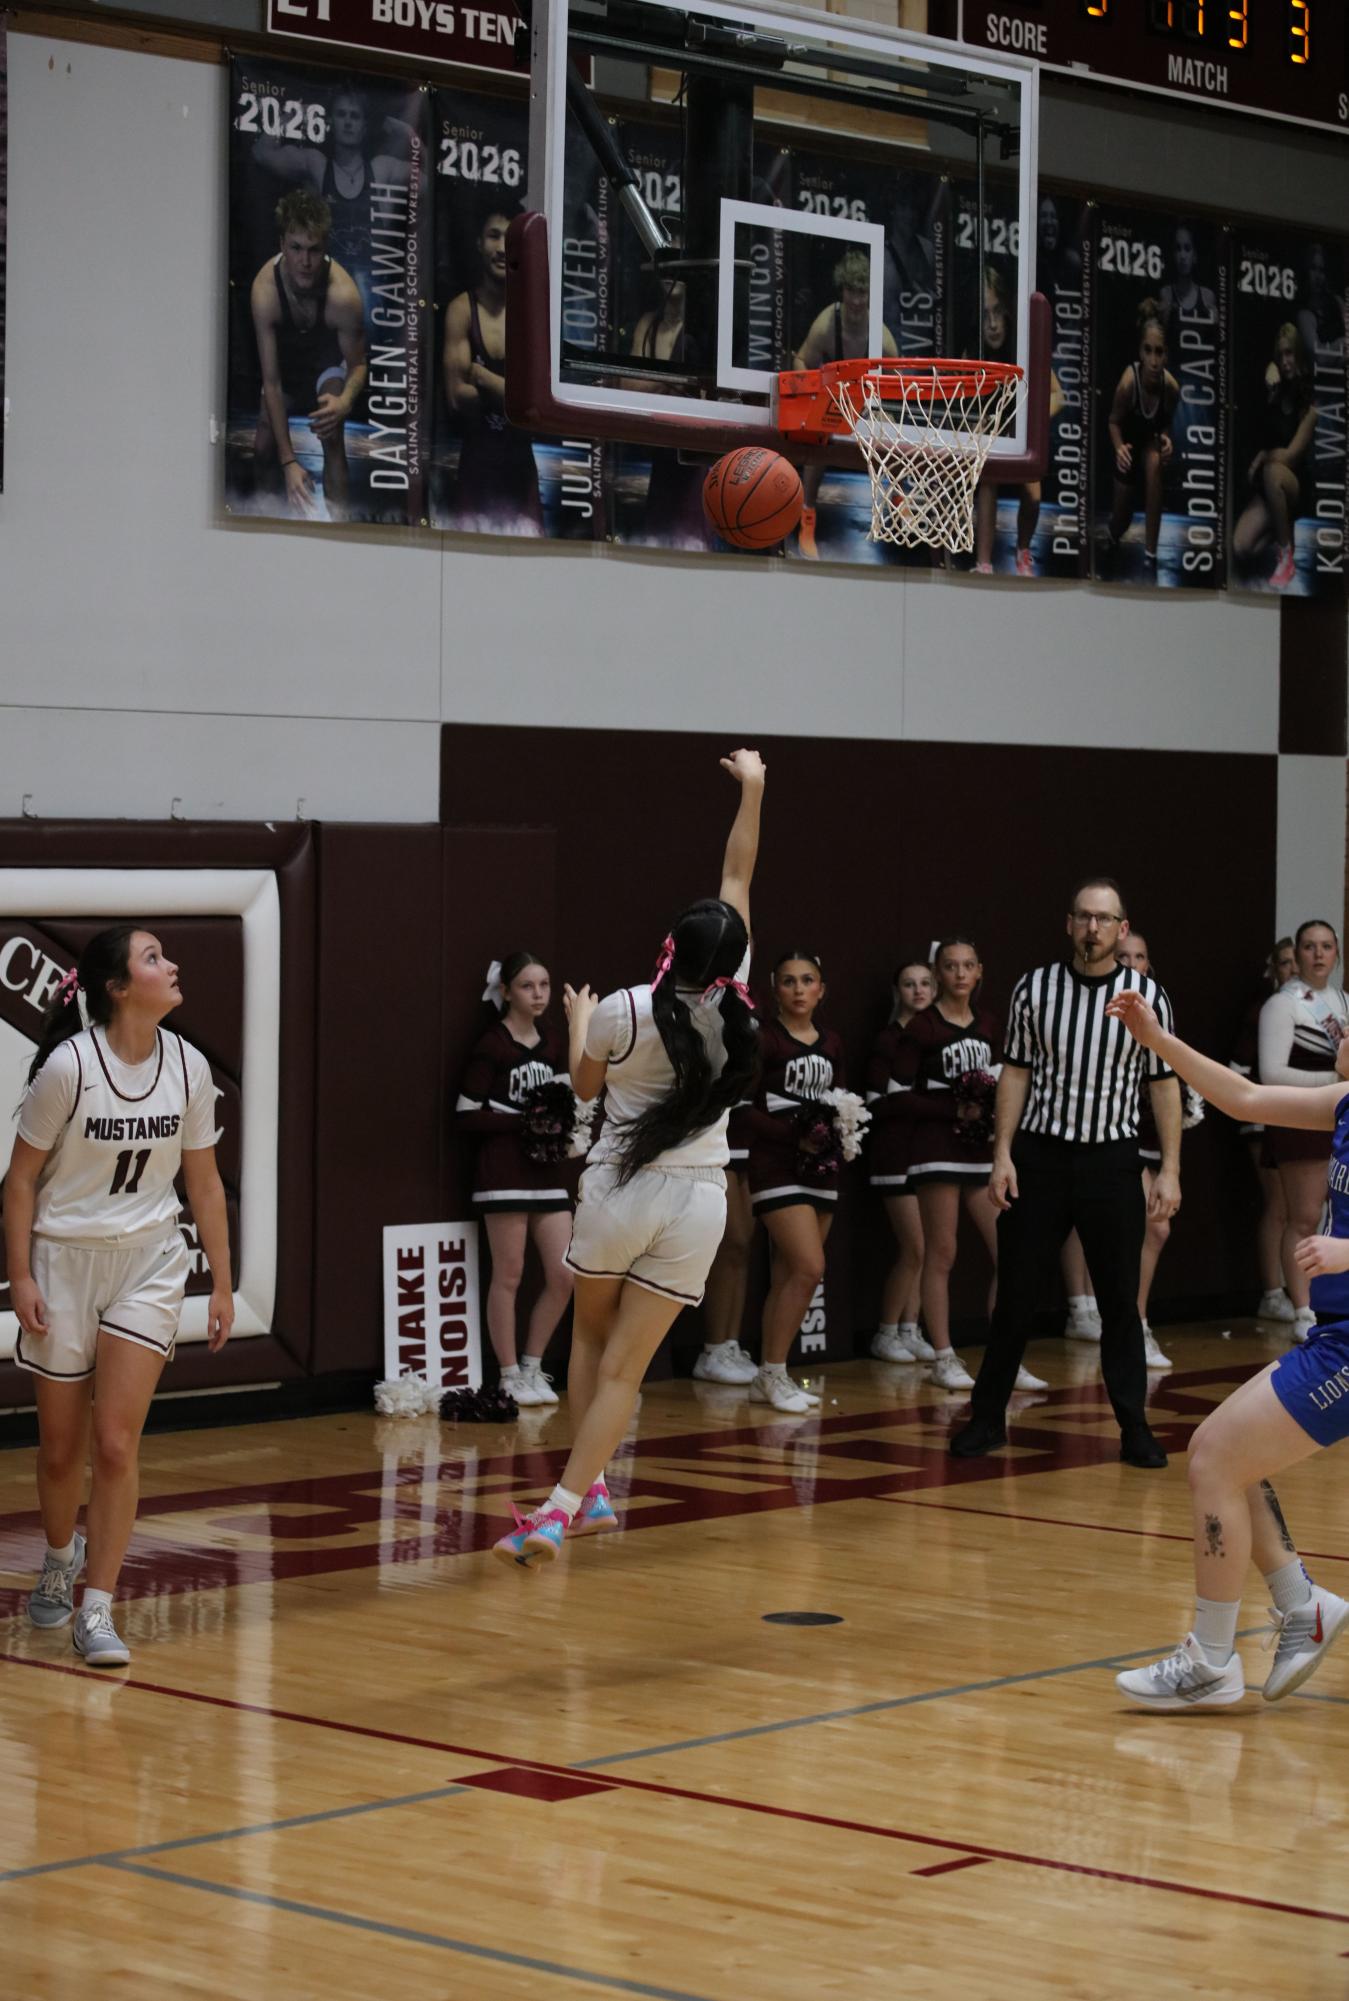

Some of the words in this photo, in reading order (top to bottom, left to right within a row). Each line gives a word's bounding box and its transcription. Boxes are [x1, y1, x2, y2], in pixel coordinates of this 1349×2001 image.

[371, 0, 454, 34] BOYS
[461, 8, 528, 46] TEN
[986, 12, 1048, 54] SCORE
[242, 76, 286, 97] Senior
[1167, 54, 1229, 94] MATCH
[236, 92, 328, 144] 2026
[443, 120, 484, 141] Senior
[408, 135, 421, 224] WRESTLING
[438, 138, 521, 187] 2026
[628, 148, 667, 169] Senior
[597, 176, 609, 259] WRESTLING
[370, 181, 409, 328] GAWITH
[406, 231, 418, 296] SCHOOL
[1098, 236, 1165, 280] 2026
[1237, 260, 1298, 301] 2026
[407, 301, 418, 341] HIGH
[597, 266, 608, 327] SCHOOL
[1051, 282, 1083, 408] Bohrer
[1179, 306, 1216, 406] CAPE
[408, 348, 419, 414] CENTRAL
[1313, 339, 1346, 460] WAITE
[368, 344, 409, 489] DAYGEN
[408, 420, 419, 475] SALINA
[593, 446, 602, 498] SALINA
[1053, 422, 1082, 555] Phoebe
[1182, 424, 1218, 573] Sophia
[1315, 482, 1346, 573] KODI
[84, 1115, 181, 1141] MUSTANGS
[109, 1149, 152, 1196] 11
[397, 1245, 427, 1381] MAKE
[438, 1238, 469, 1388] NOISE
